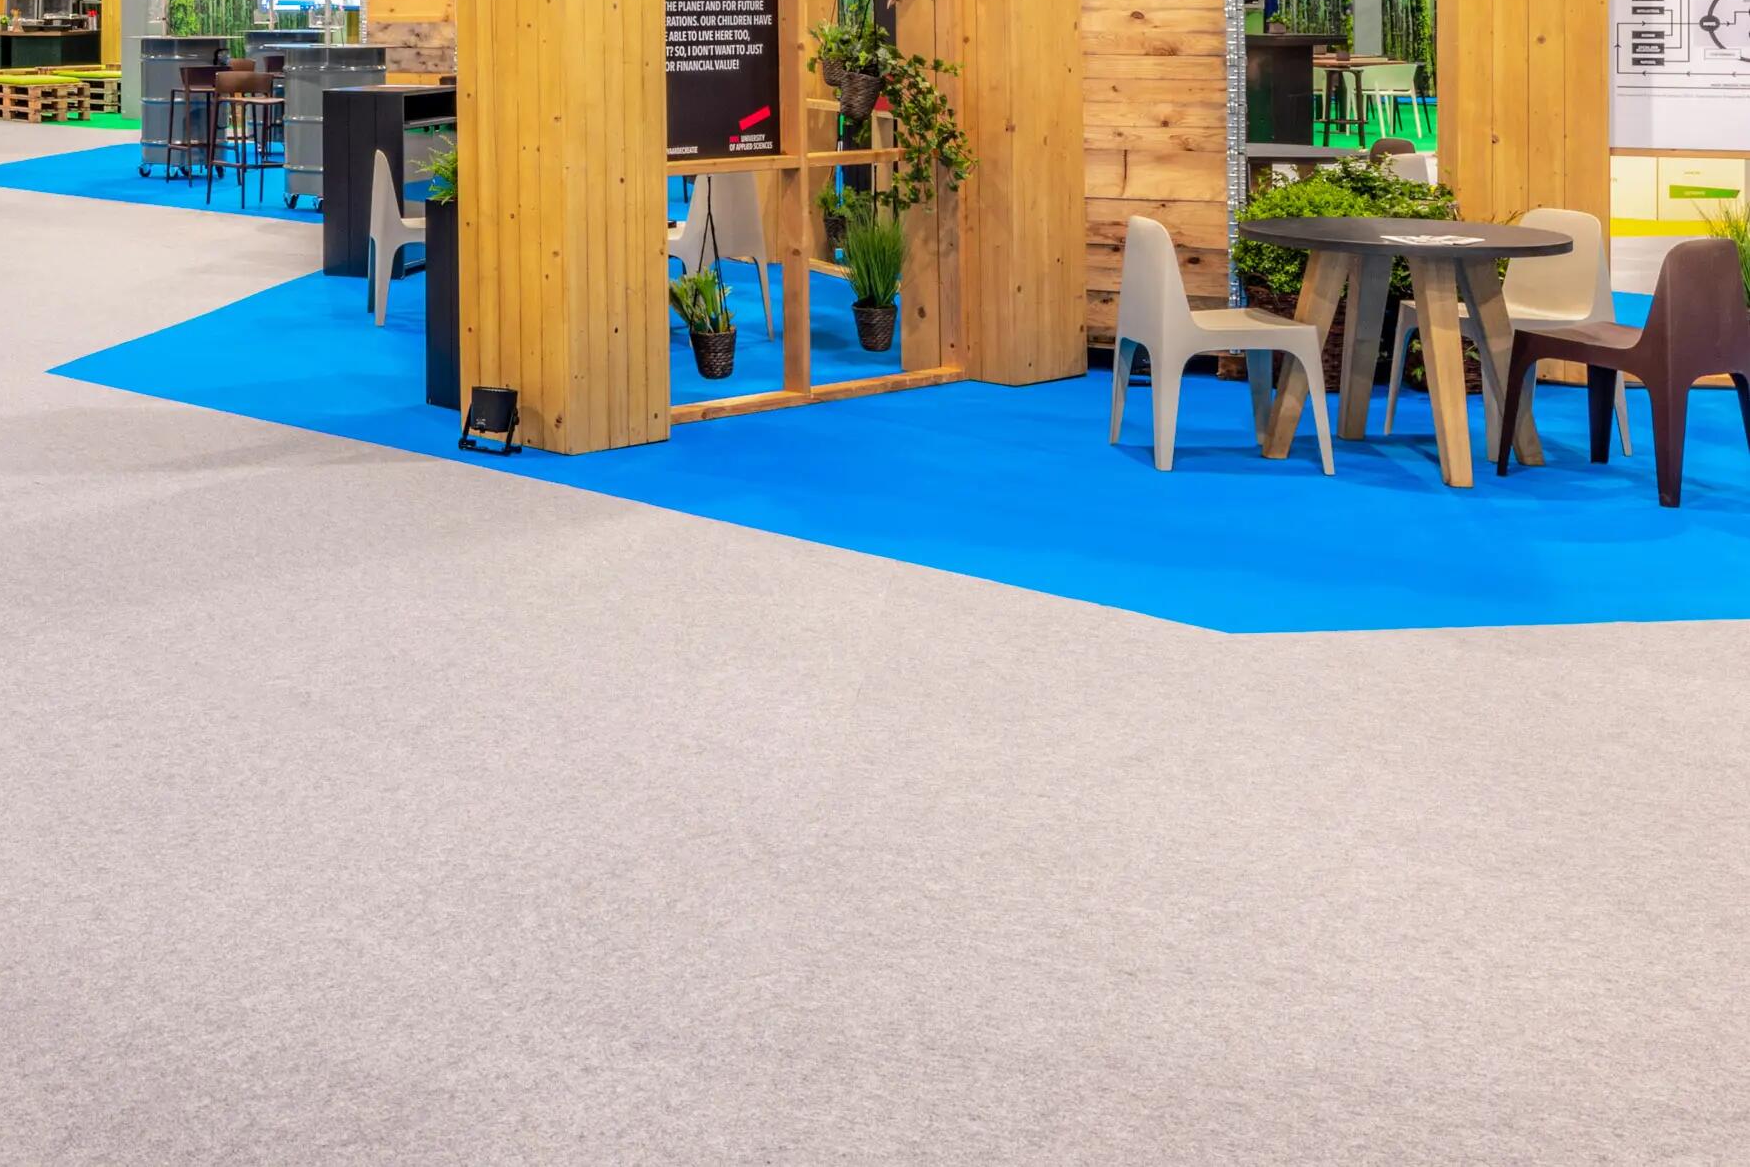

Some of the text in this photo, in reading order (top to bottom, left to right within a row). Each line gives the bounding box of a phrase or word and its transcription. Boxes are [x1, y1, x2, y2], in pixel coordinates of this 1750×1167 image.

[678, 1, 705, 12] PLANET
[705, 0, 721, 11] AND
[722, 0, 737, 11] FOR
[737, 0, 764, 11] FUTURE
[700, 15, 717, 26] OUR
[717, 15, 753, 26] CHILDREN
[753, 14, 773, 26] HAVE
[668, 29, 751, 42] ABLE TO LIVE HERE TOO,
[674, 45, 687, 58] SO,
[692, 45, 715, 57] DON'T
[714, 44, 736, 56] WANT
[735, 44, 746, 55] TO
[746, 43, 764, 55] JUST
[676, 60, 715, 72] FINANCIAL
[714, 59, 740, 71] VALUE!
[740, 134, 765, 142] UNIVERSITY
[729, 141, 773, 152] OF APPLIED SCIENCES
